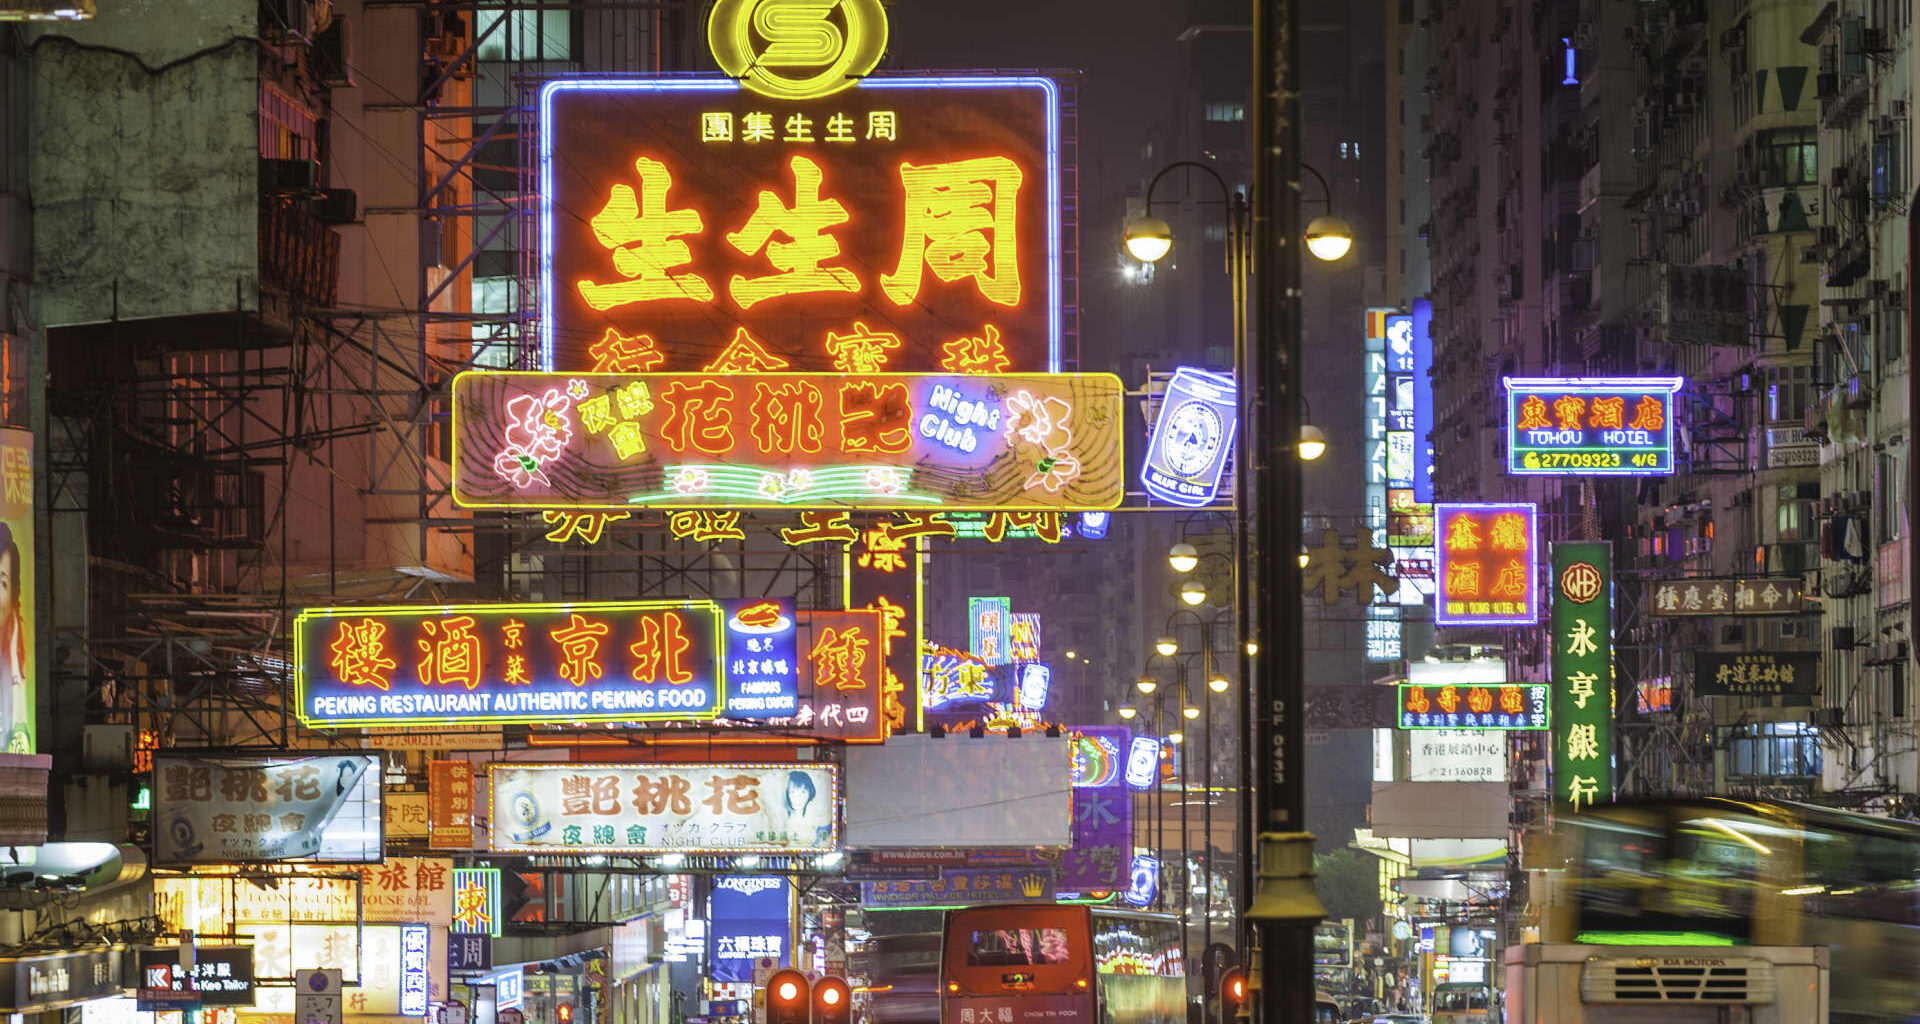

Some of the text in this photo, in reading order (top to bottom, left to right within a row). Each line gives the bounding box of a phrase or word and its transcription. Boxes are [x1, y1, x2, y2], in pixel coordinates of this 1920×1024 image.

[929, 384, 1000, 431] Night
[919, 413, 977, 453] Club
[1527, 430, 1654, 444] TOHOU HOTEL
[1540, 453, 1620, 467] 27709323
[1151, 471, 1205, 496] BLUE GIRL
[740, 681, 781, 694] FAMOUS
[314, 688, 706, 714] PEKING RESTAURANT AUTHENTIC PEKING FOOD
[728, 695, 794, 710] PEKING DUCK
[1567, 619, 1599, 813] 永亨銀行
[562, 824, 648, 845] 夜總會
[660, 836, 746, 847] NIGHT CLUB
[716, 877, 782, 889] LONGINES
[453, 881, 494, 928] 東
[1683, 958, 1726, 967] MOTORS
[201, 980, 222, 991] Kee
[223, 980, 248, 991] Tailor
[959, 1006, 1014, 1024] 周大福
